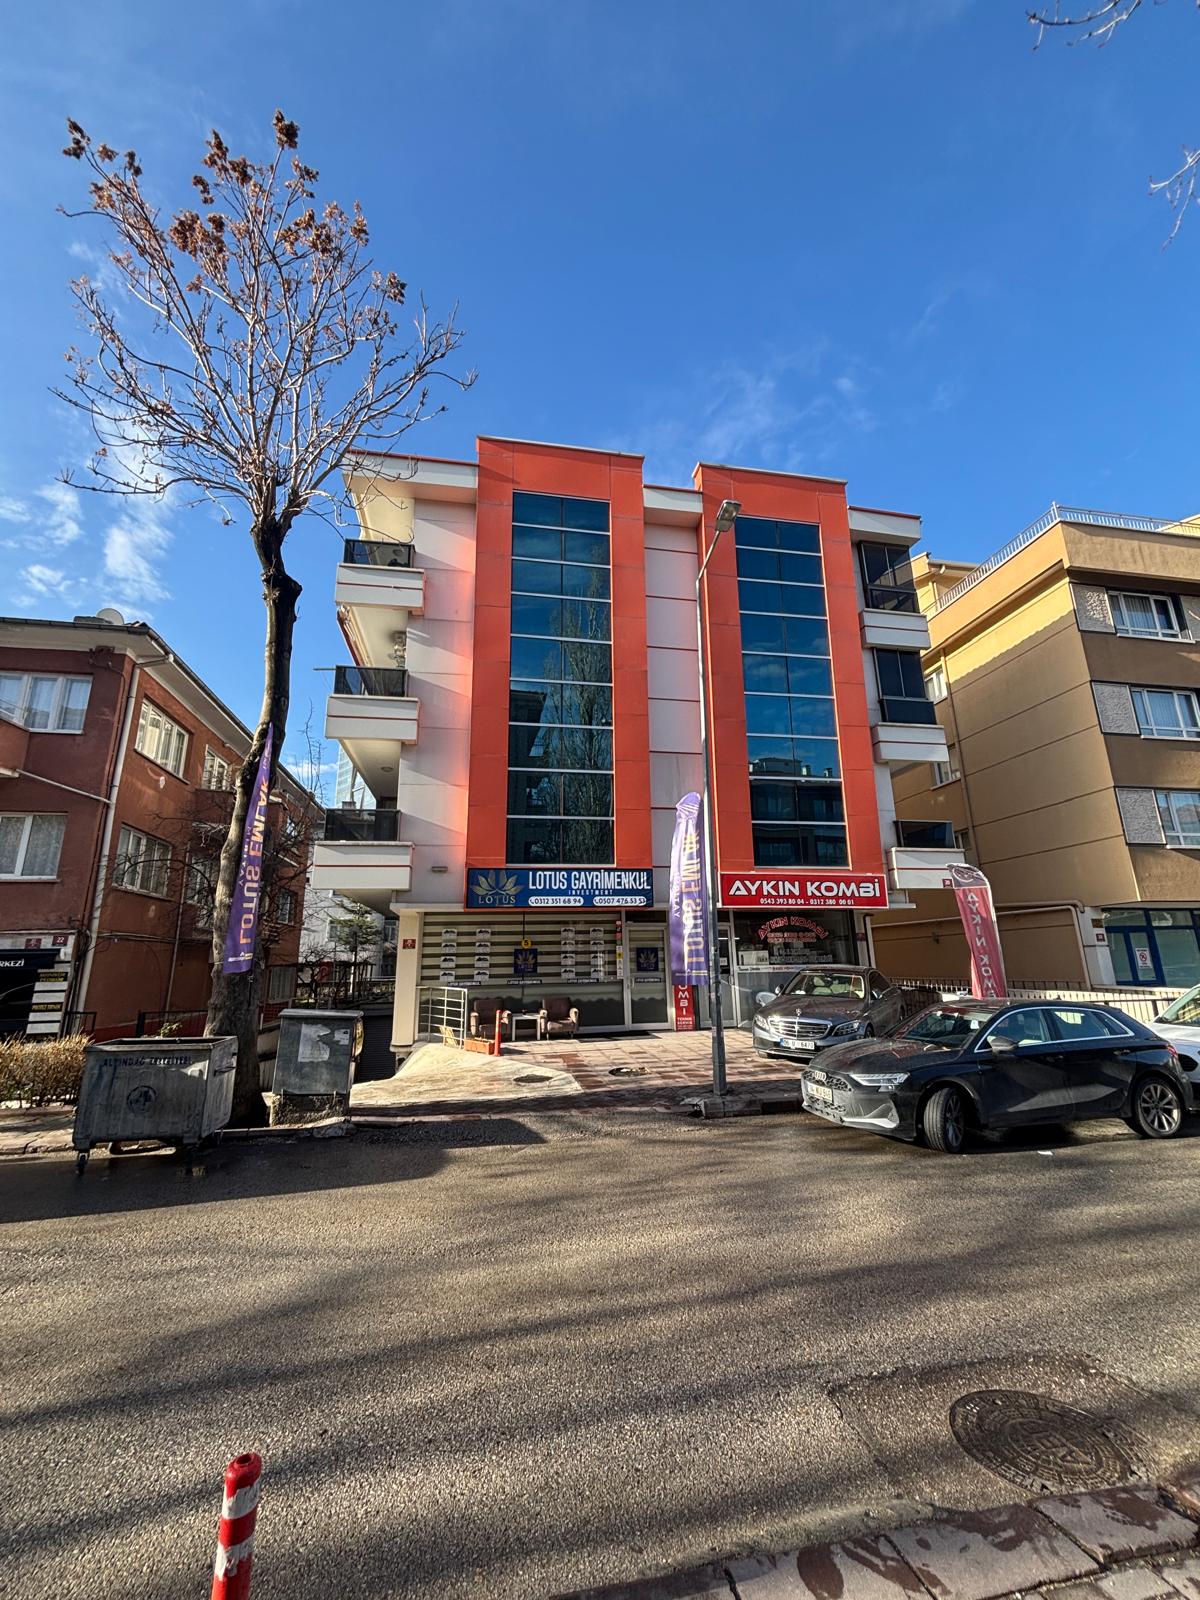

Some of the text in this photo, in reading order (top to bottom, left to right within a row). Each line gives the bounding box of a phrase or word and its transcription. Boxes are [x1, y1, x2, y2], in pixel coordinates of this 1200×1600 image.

[528, 869, 651, 890] LOTUS GAYRİMENKUL
[729, 879, 880, 897] AYKIN KOMBİ
[479, 896, 516, 904] LOTUS
